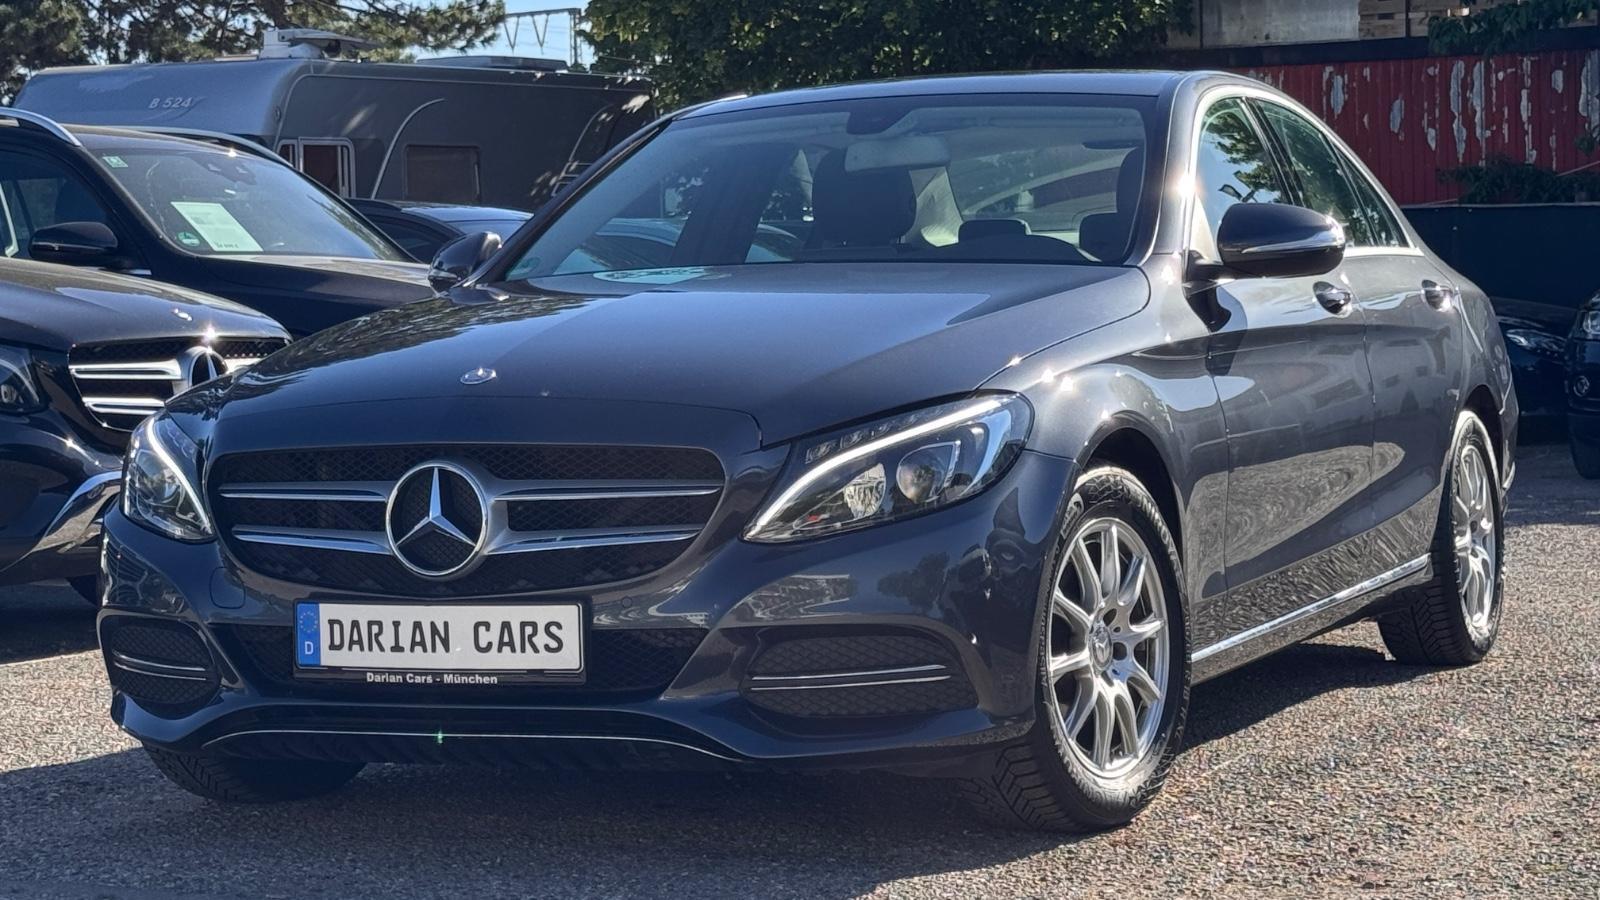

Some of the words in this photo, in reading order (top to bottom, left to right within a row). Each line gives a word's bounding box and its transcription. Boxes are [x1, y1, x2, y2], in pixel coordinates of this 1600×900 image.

[149, 98, 160, 109] B
[162, 97, 193, 109] 524
[328, 620, 451, 653] DARIAN
[473, 622, 564, 653] CARS
[304, 641, 314, 655] D
[366, 672, 403, 683] Darian
[406, 674, 433, 684] Cars
[443, 674, 498, 685] München
